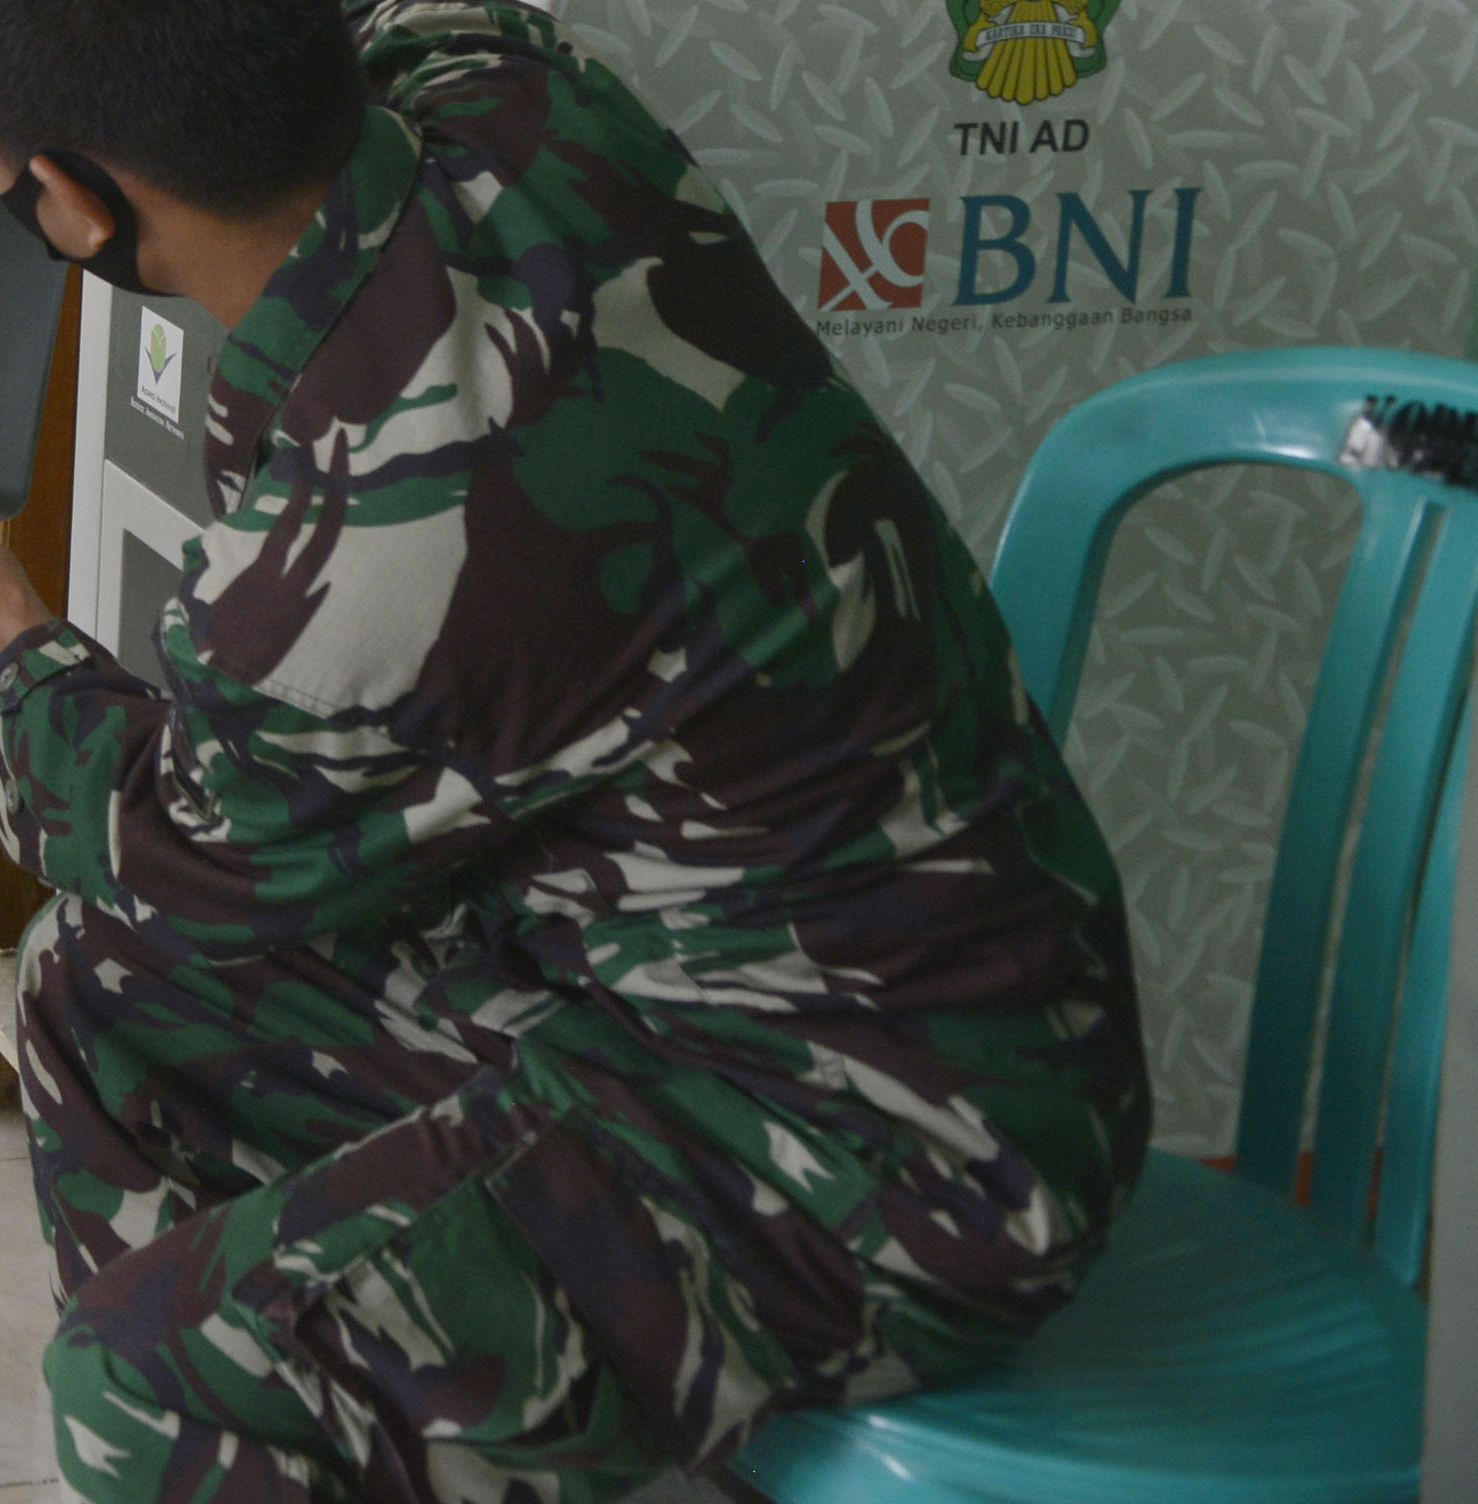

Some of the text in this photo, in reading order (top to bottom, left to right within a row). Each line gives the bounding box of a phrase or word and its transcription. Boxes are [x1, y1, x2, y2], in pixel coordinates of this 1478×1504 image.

[953, 119, 1090, 156] TNI AD
[950, 186, 1204, 306] BNI
[816, 307, 1194, 338] Melayani Negeri, Kebanggaan Bangsa
